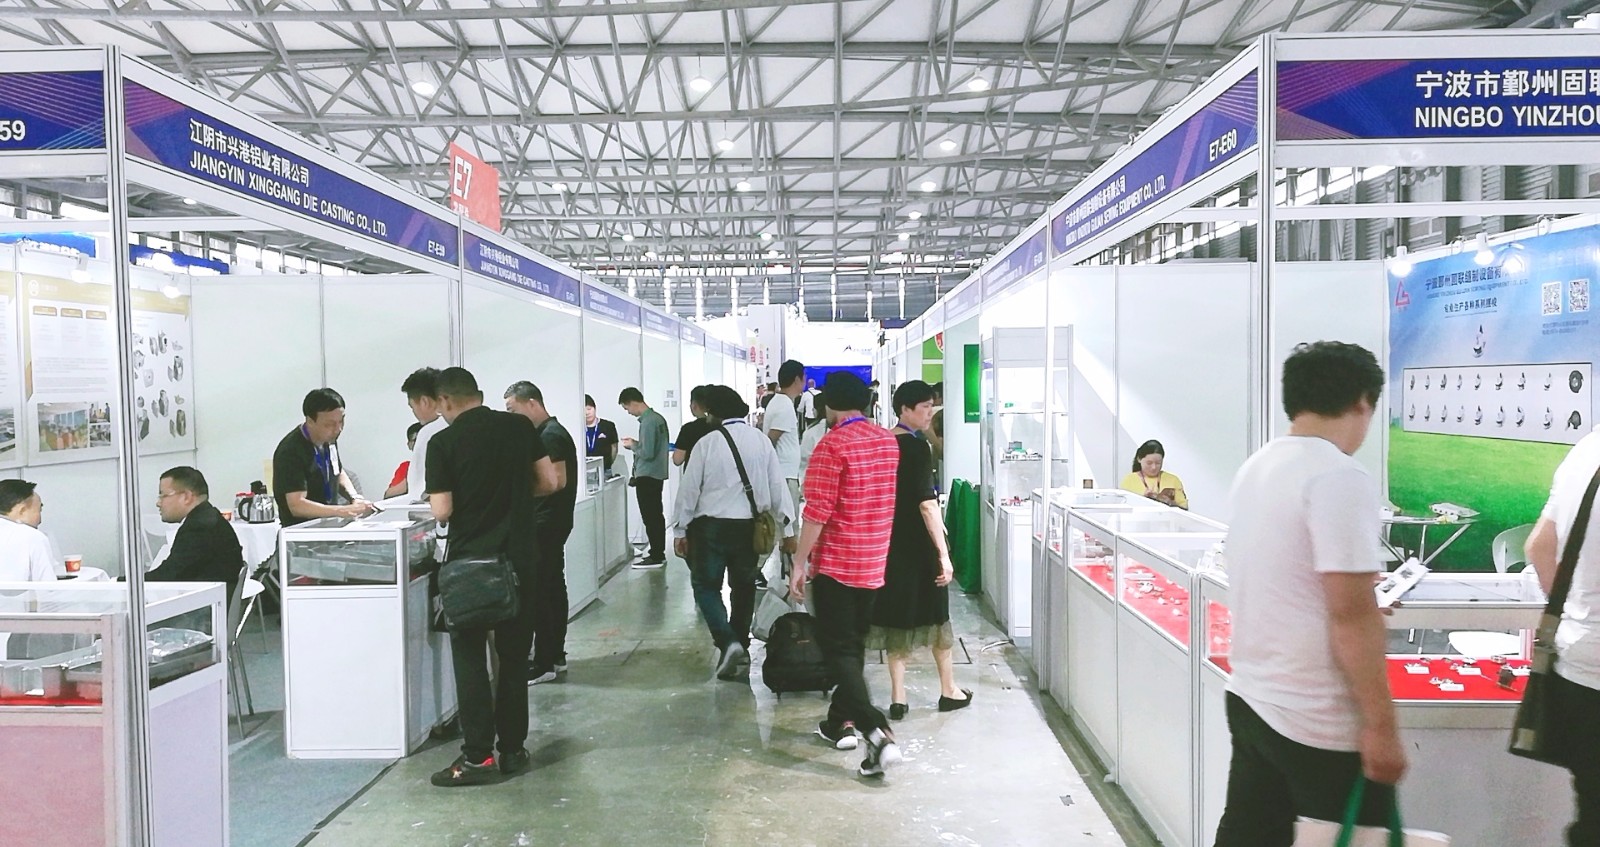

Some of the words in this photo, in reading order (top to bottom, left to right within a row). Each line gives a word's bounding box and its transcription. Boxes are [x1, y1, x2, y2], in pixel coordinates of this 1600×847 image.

[1415, 106, 1504, 128] NINGBO
[189, 117, 309, 187] 江阴市兴港铝业有限公司
[1209, 128, 1237, 163] E7-E60
[189, 150, 245, 186] JIANGYIN
[248, 171, 301, 206] XINGGANG
[303, 193, 318, 213] DIE
[320, 200, 355, 225] CASTING
[356, 213, 372, 234] CO.,
[372, 219, 388, 238] LTD.
[453, 155, 473, 200] E7
